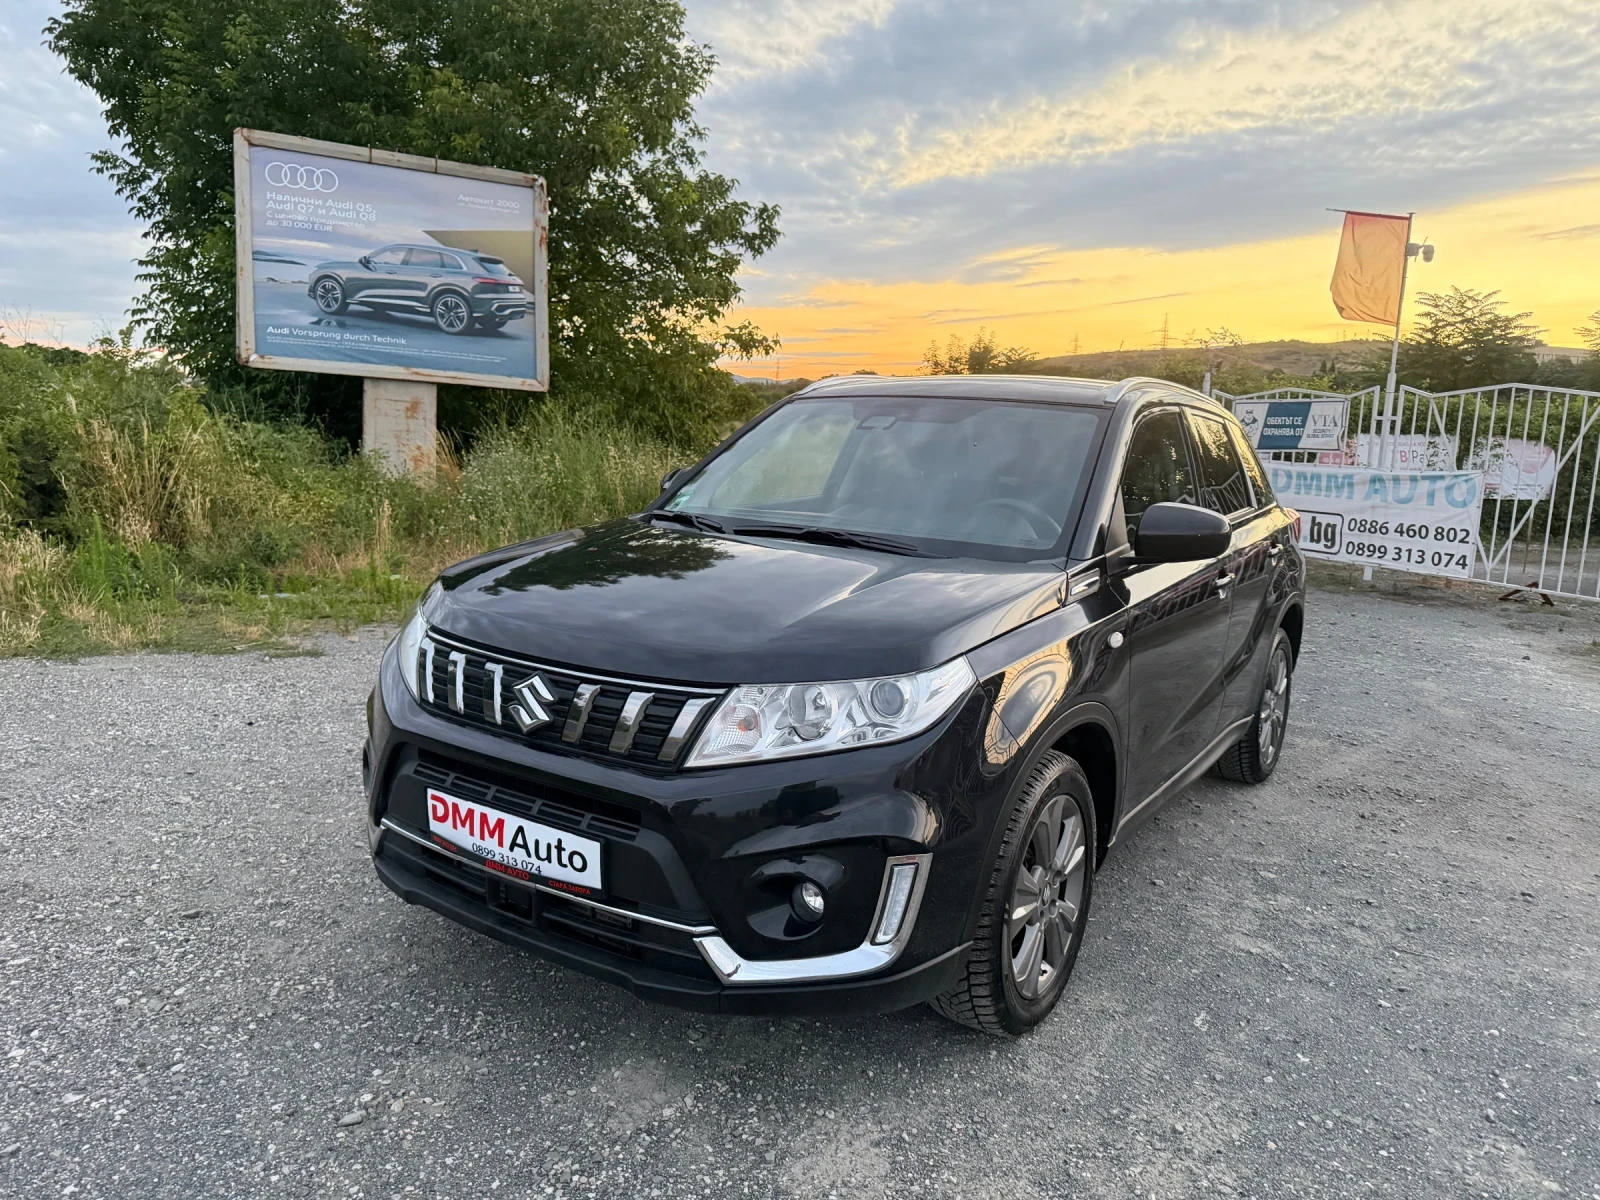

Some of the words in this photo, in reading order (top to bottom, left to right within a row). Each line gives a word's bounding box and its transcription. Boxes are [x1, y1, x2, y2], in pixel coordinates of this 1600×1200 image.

[266, 191, 322, 206] Налични
[325, 199, 353, 210] Audi
[356, 203, 377, 213] Q5,
[266, 200, 294, 211] Audi
[297, 204, 314, 213] Q7
[318, 207, 326, 215] и
[329, 208, 356, 219] Audi
[359, 212, 376, 221] Q8
[497, 199, 520, 209] 2000
[275, 213, 308, 221] ценово
[310, 216, 365, 229] предимство
[294, 221, 313, 230] 000
[314, 224, 333, 232] EUR
[266, 326, 289, 335] Audi
[292, 328, 341, 340] Vorsprung
[343, 332, 370, 342] durch
[372, 334, 407, 345] Technik
[1266, 416, 1293, 425] ОБЕКТЪТ
[1293, 416, 1303, 425] СЕ
[1311, 414, 1339, 427] VTA
[1262, 427, 1294, 436] ОХРАНЯВА
[1295, 427, 1304, 436] ОТ
[1271, 468, 1354, 500] DMM
[1364, 474, 1477, 509] AUTO
[1347, 518, 1389, 535] 0886
[1394, 522, 1429, 539] 460
[1433, 526, 1470, 544] 802
[1345, 541, 1387, 559] 0899
[1392, 546, 1425, 564] 313
[1431, 551, 1468, 569] 074
[471, 842, 496, 859] 0899
[498, 853, 518, 867] 313
[521, 860, 542, 875] 074
[485, 859, 505, 872] ДММ
[506, 867, 530, 880] АУТО
[548, 880, 568, 890] СТАРА
[568, 884, 591, 895] ЗАГОРА
